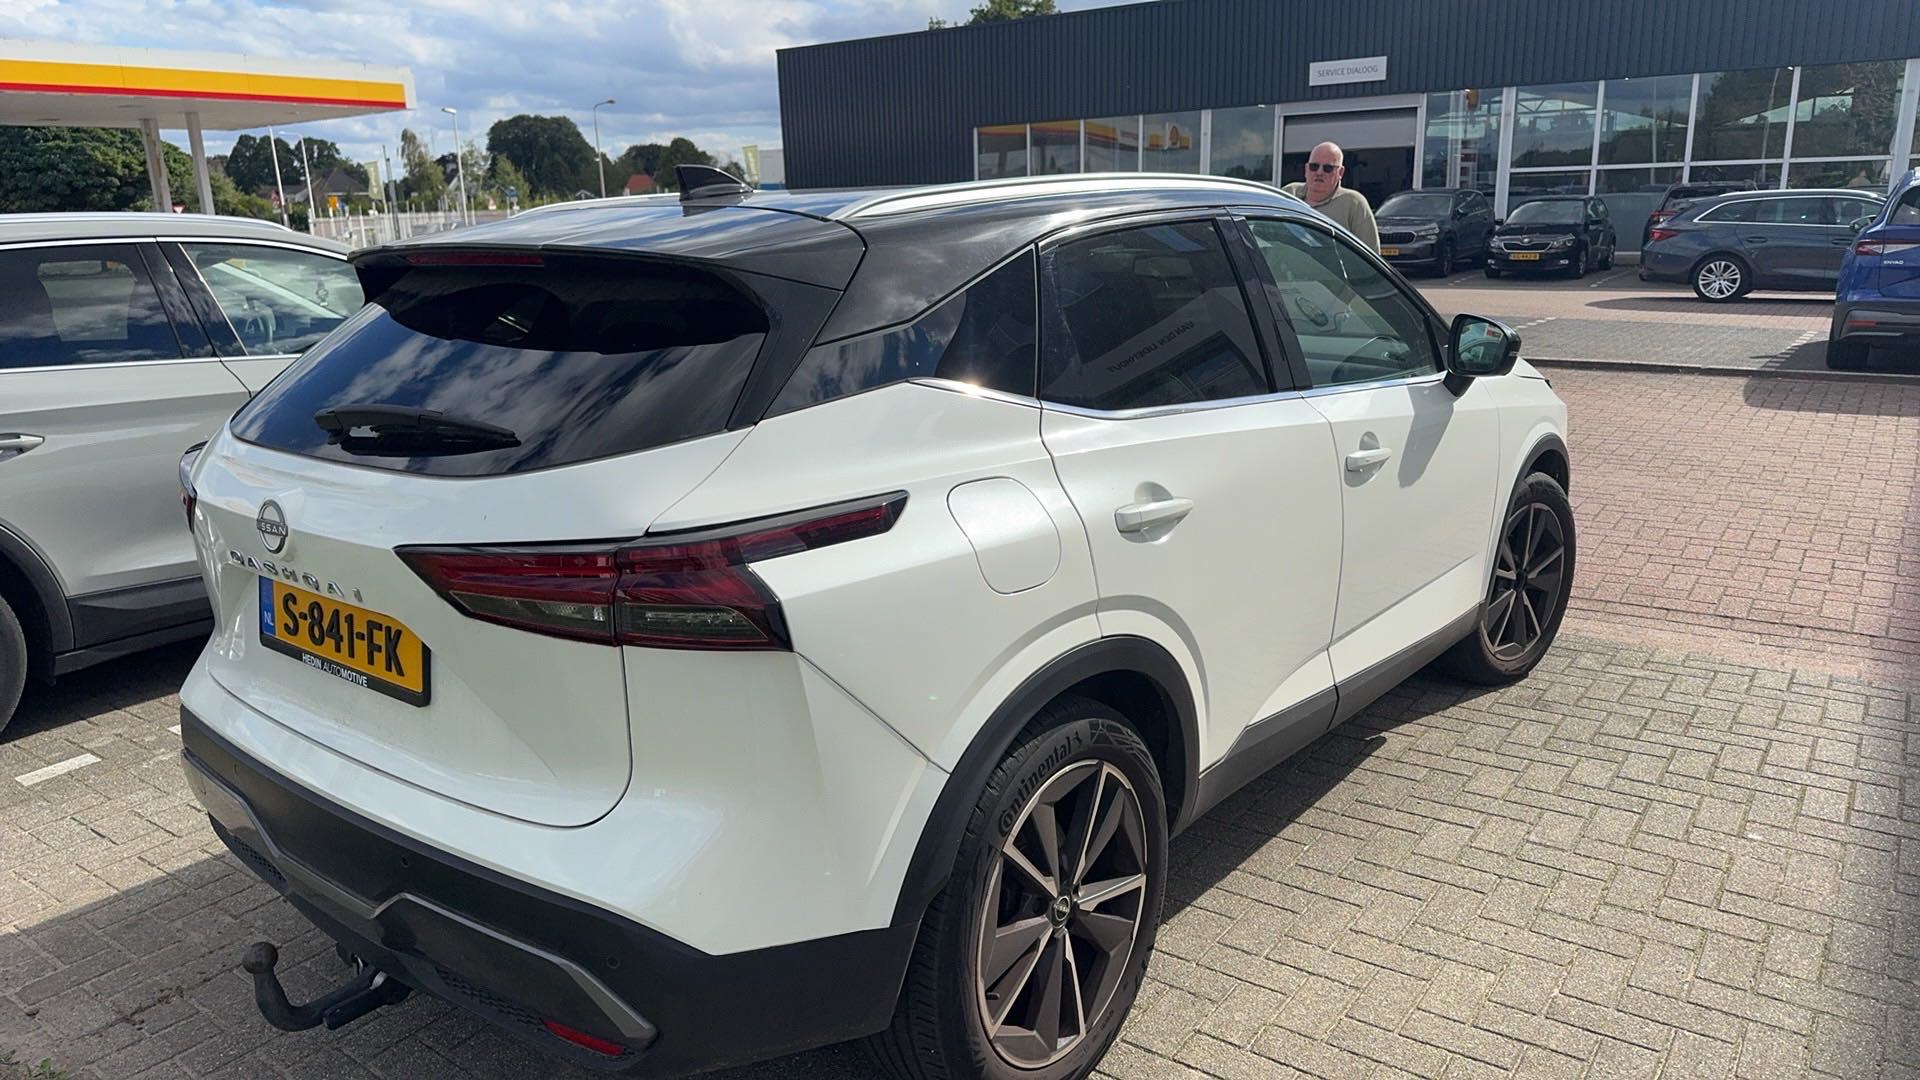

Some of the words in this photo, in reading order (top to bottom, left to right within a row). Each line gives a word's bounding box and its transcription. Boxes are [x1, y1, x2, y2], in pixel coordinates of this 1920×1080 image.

[1317, 68, 1345, 78] SERVICE
[1346, 65, 1378, 75] DIALOOG
[258, 520, 286, 537] SSAN
[230, 549, 364, 603] QASHQAI
[263, 611, 275, 627] NL
[282, 592, 405, 677] S-841-FK
[301, 653, 323, 671] HEDIN
[322, 660, 368, 688] AUTOMOTIVE
[998, 736, 1072, 838] Continental
